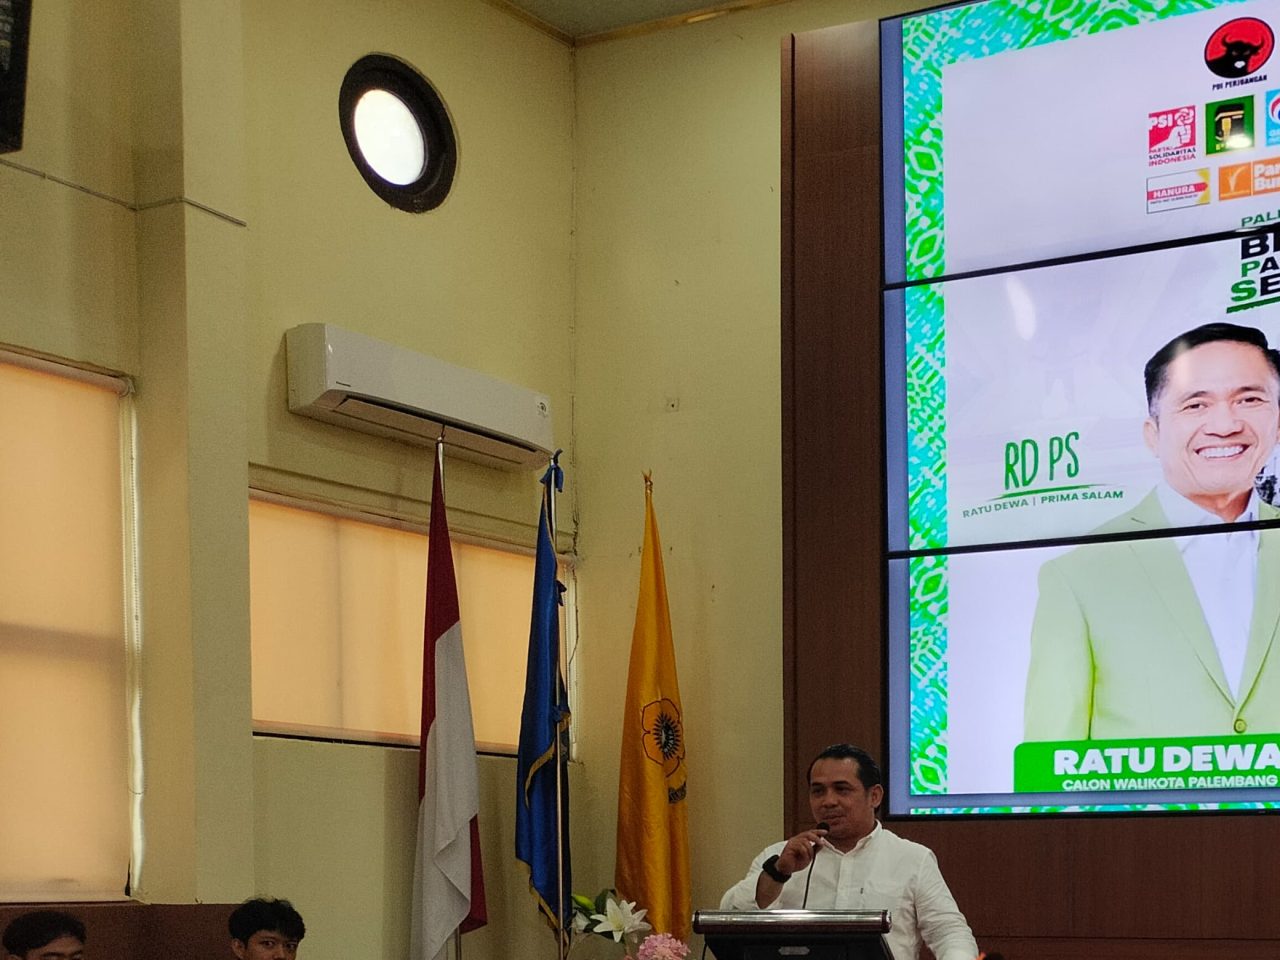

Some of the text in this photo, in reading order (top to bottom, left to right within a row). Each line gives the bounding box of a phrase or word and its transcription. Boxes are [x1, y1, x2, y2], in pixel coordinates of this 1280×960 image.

[1149, 113, 1173, 130] PSI
[1149, 153, 1197, 166] INDONESIA
[1153, 184, 1196, 199] HANURA
[1004, 431, 1079, 490] RD PS
[963, 490, 1124, 518] RATU DEWA PRIMA SALAM
[1054, 746, 1155, 775] RATU
[1062, 775, 1278, 791] CALON WALIKOTA PALEMBANG
